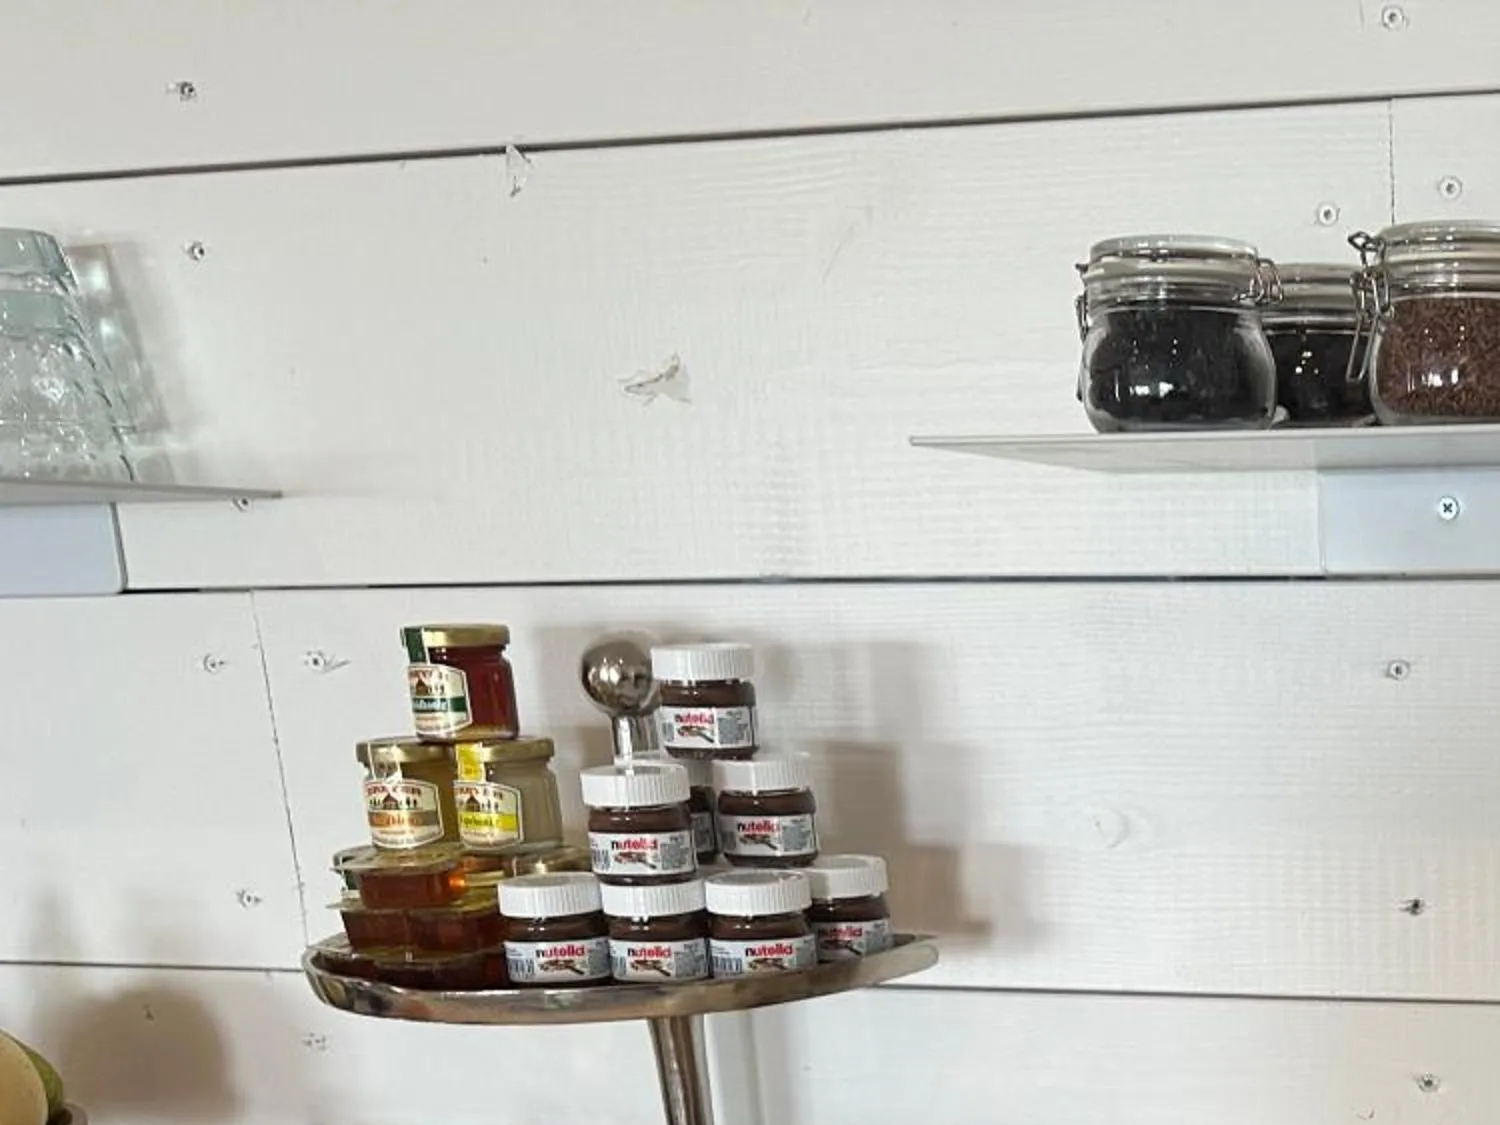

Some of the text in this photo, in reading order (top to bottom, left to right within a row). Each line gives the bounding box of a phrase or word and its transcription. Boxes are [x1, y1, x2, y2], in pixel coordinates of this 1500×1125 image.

[674, 713, 714, 724] nutella
[737, 819, 780, 832] nutella
[611, 837, 658, 849] nutella
[536, 944, 585, 957] nutella
[628, 946, 671, 958] nutella
[745, 944, 793, 957] nutella
